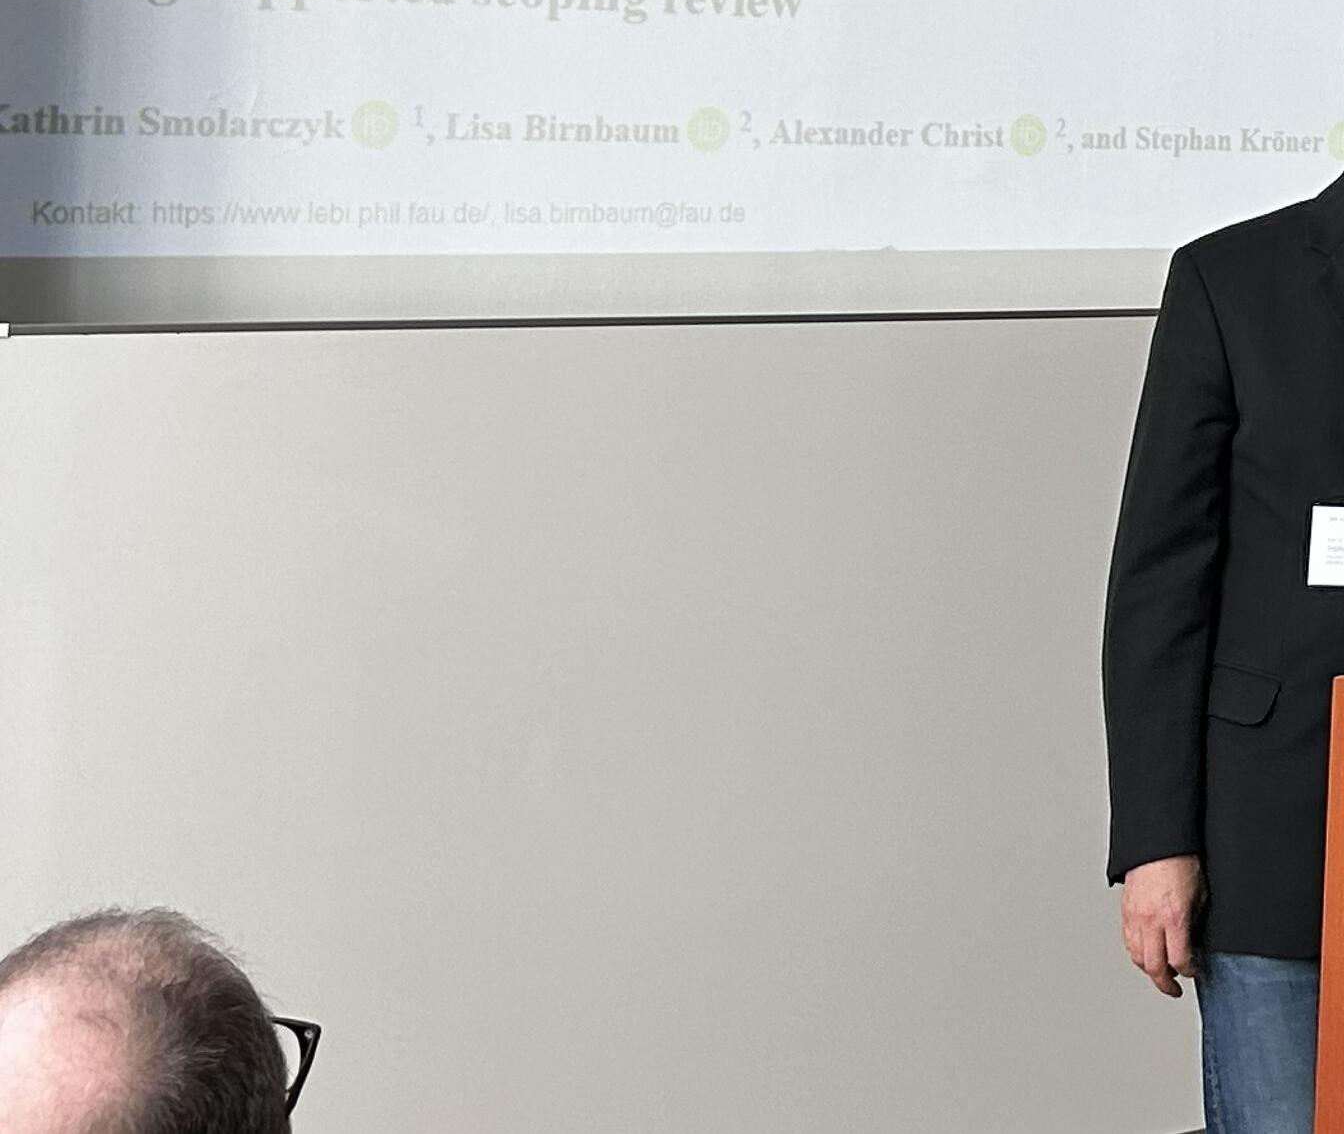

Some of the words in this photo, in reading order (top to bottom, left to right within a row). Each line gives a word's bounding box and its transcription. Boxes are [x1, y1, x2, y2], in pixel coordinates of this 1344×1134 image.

[138, 106, 346, 144] Smolarczyk
[445, 111, 513, 142] Lisa
[523, 112, 681, 144] Birnbaum
[769, 118, 914, 149] Alexander
[922, 121, 1005, 150] Christ
[1081, 127, 1128, 154] and
[1135, 125, 1231, 162] Stephan
[1240, 127, 1324, 156] Kröner
[32, 201, 143, 226] Kontakt:
